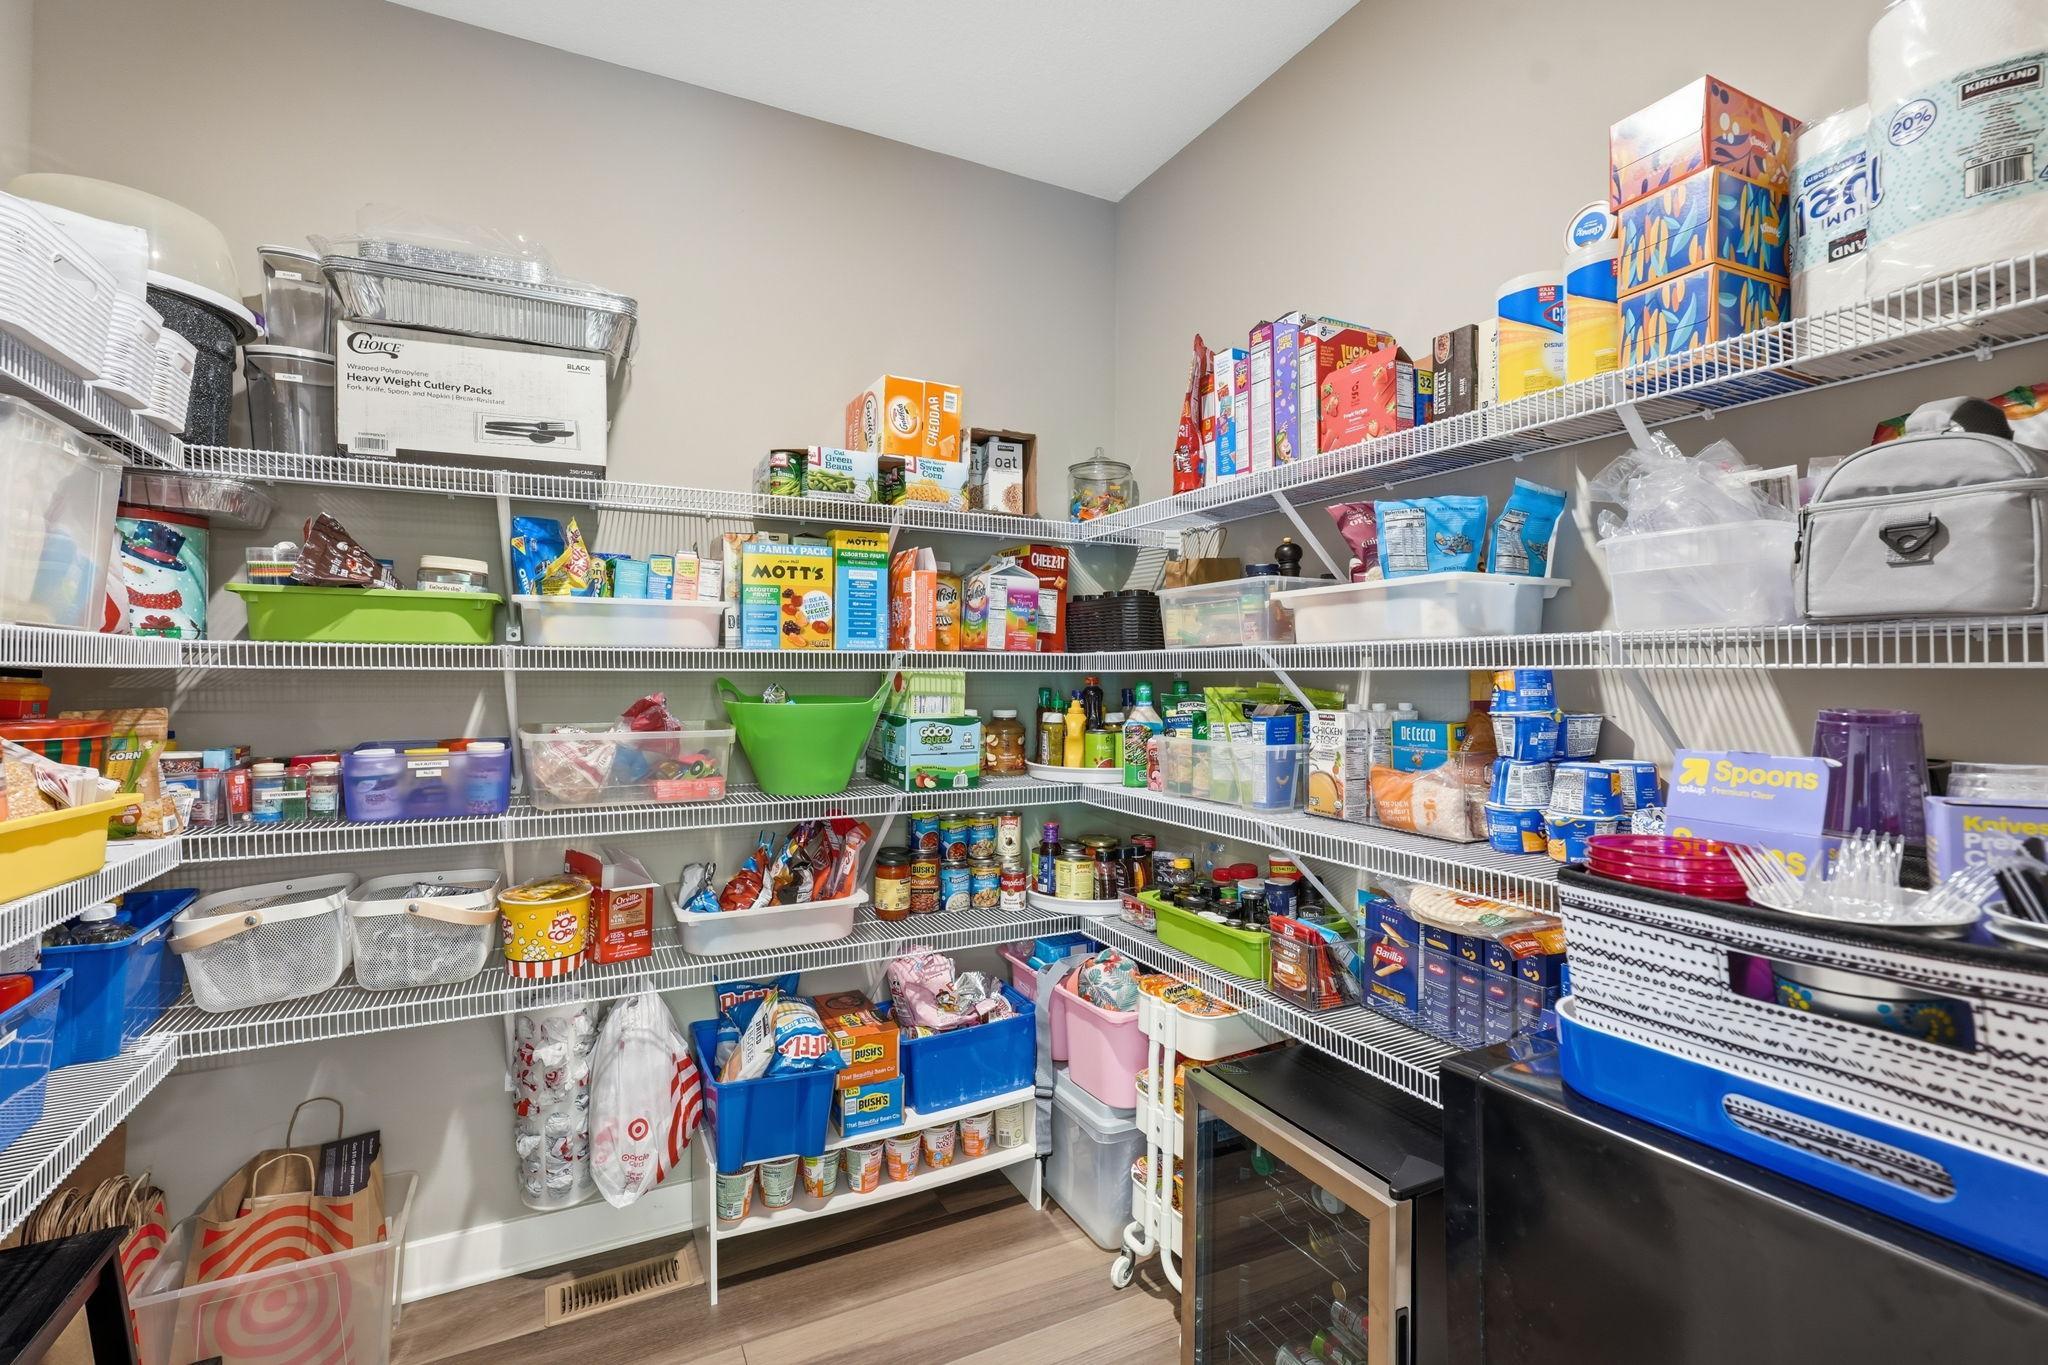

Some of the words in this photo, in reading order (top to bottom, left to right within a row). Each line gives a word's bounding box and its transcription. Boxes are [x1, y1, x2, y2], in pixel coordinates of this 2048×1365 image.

[1964, 67, 2038, 93] KIRKLAND
[1891, 111, 1932, 137] 20%
[347, 332, 402, 359] CHOICE
[347, 363, 379, 372] Wrapped
[380, 365, 429, 378] Polypropylene
[567, 364, 591, 372] BLACK
[347, 373, 381, 384] Heavy
[383, 376, 421, 388] Weight
[424, 380, 461, 393] Cutlery
[464, 384, 492, 395] Packs
[1420, 377, 1431, 389] 32
[366, 385, 385, 393] Knife,
[388, 387, 411, 397] Spoon,
[427, 391, 451, 400] Napkin
[1438, 368, 1446, 414] OATMEAL
[927, 396, 940, 447] CHEDDAR
[825, 454, 853, 464] Green
[995, 457, 1017, 468] oat
[825, 461, 853, 471] Beans
[920, 463, 945, 473] Sweet
[922, 470, 942, 480] Corn
[847, 538, 878, 547] MOTT'S
[759, 545, 800, 554] FAMILY
[800, 547, 828, 556] PACK
[1031, 553, 1066, 570] CHEEZ-IT
[751, 564, 824, 580] MOTT'S
[1312, 725, 1343, 735] CHICKEN
[1316, 735, 1339, 745] STOCK
[109, 751, 141, 760] CORN
[1714, 760, 1819, 791] Spoons
[1677, 785, 1706, 795] up&up
[1751, 790, 1776, 800] Clear
[912, 865, 935, 874] BUSH'S
[616, 894, 640, 905] Orville
[552, 916, 577, 930] POP
[548, 928, 577, 941] CORN
[1375, 946, 1403, 962] Barilla
[855, 1046, 883, 1060] BUSH'S
[853, 1070, 874, 1080] Beautiful
[858, 1095, 888, 1110] BUSH'S
[847, 1121, 857, 1129] That
[858, 1118, 879, 1128] Beautiful
